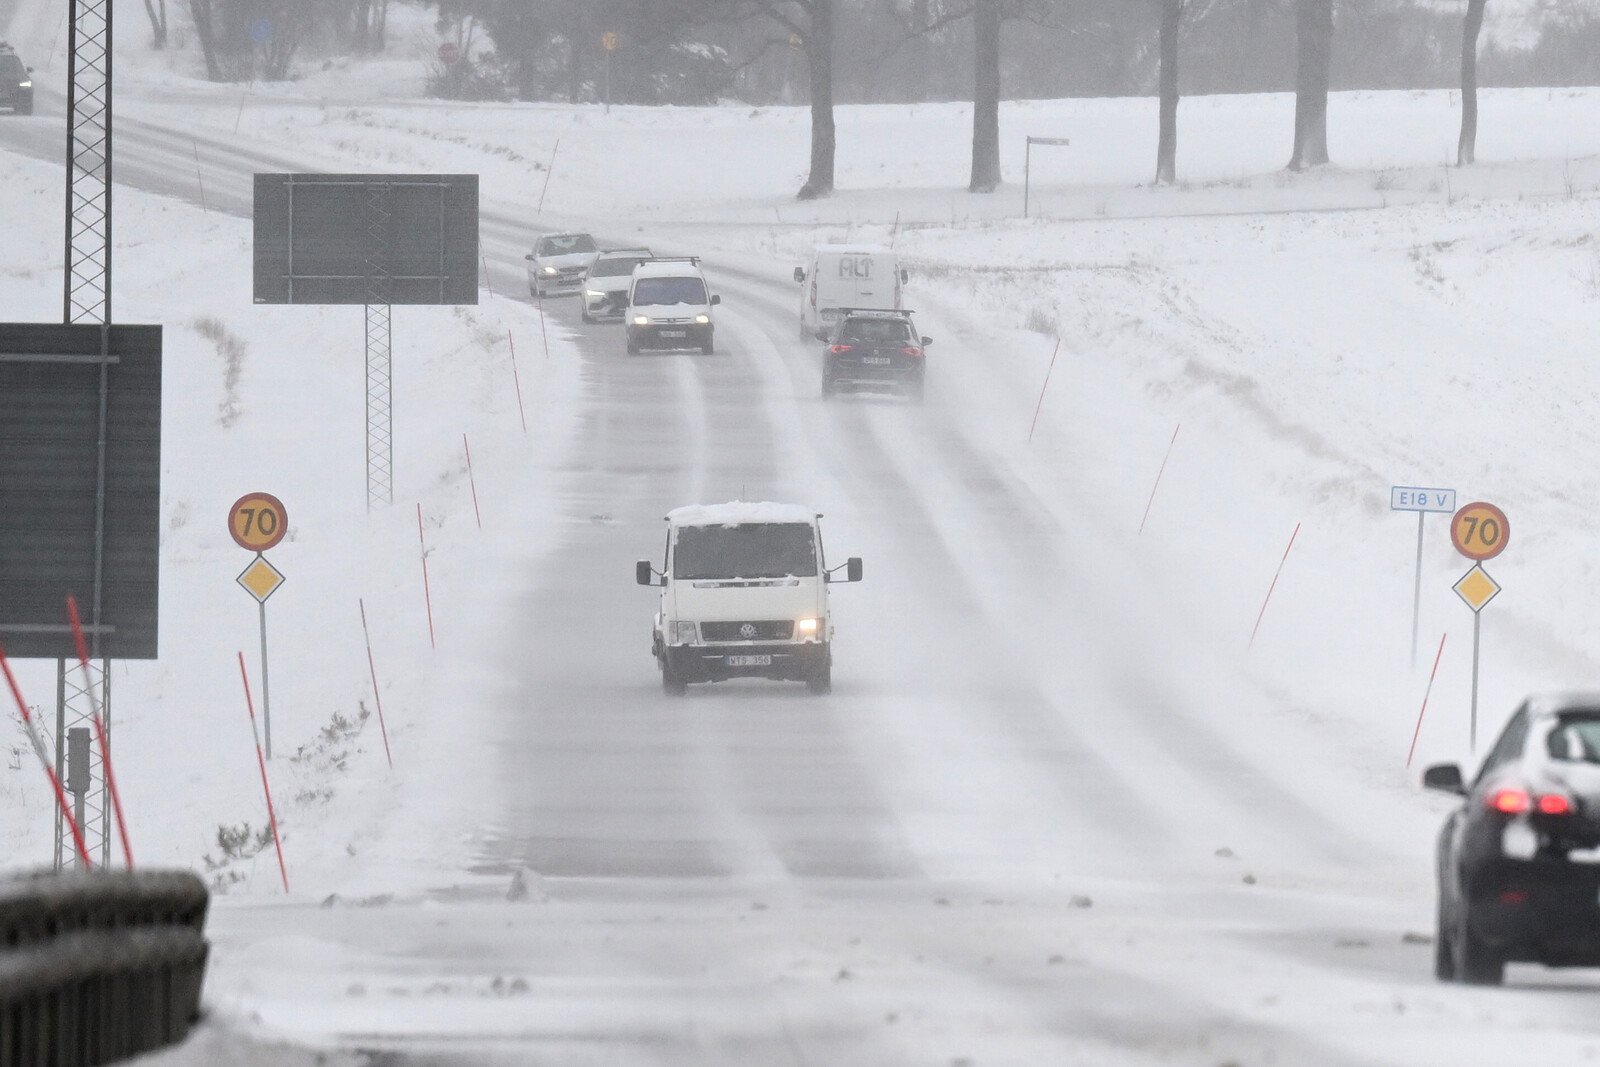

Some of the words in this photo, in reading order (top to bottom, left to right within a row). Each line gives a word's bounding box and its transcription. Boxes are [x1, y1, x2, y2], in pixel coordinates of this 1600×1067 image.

[1400, 492, 1428, 506] E18
[1436, 494, 1448, 506] V
[240, 508, 277, 536] 70
[1464, 516, 1500, 546] 70
